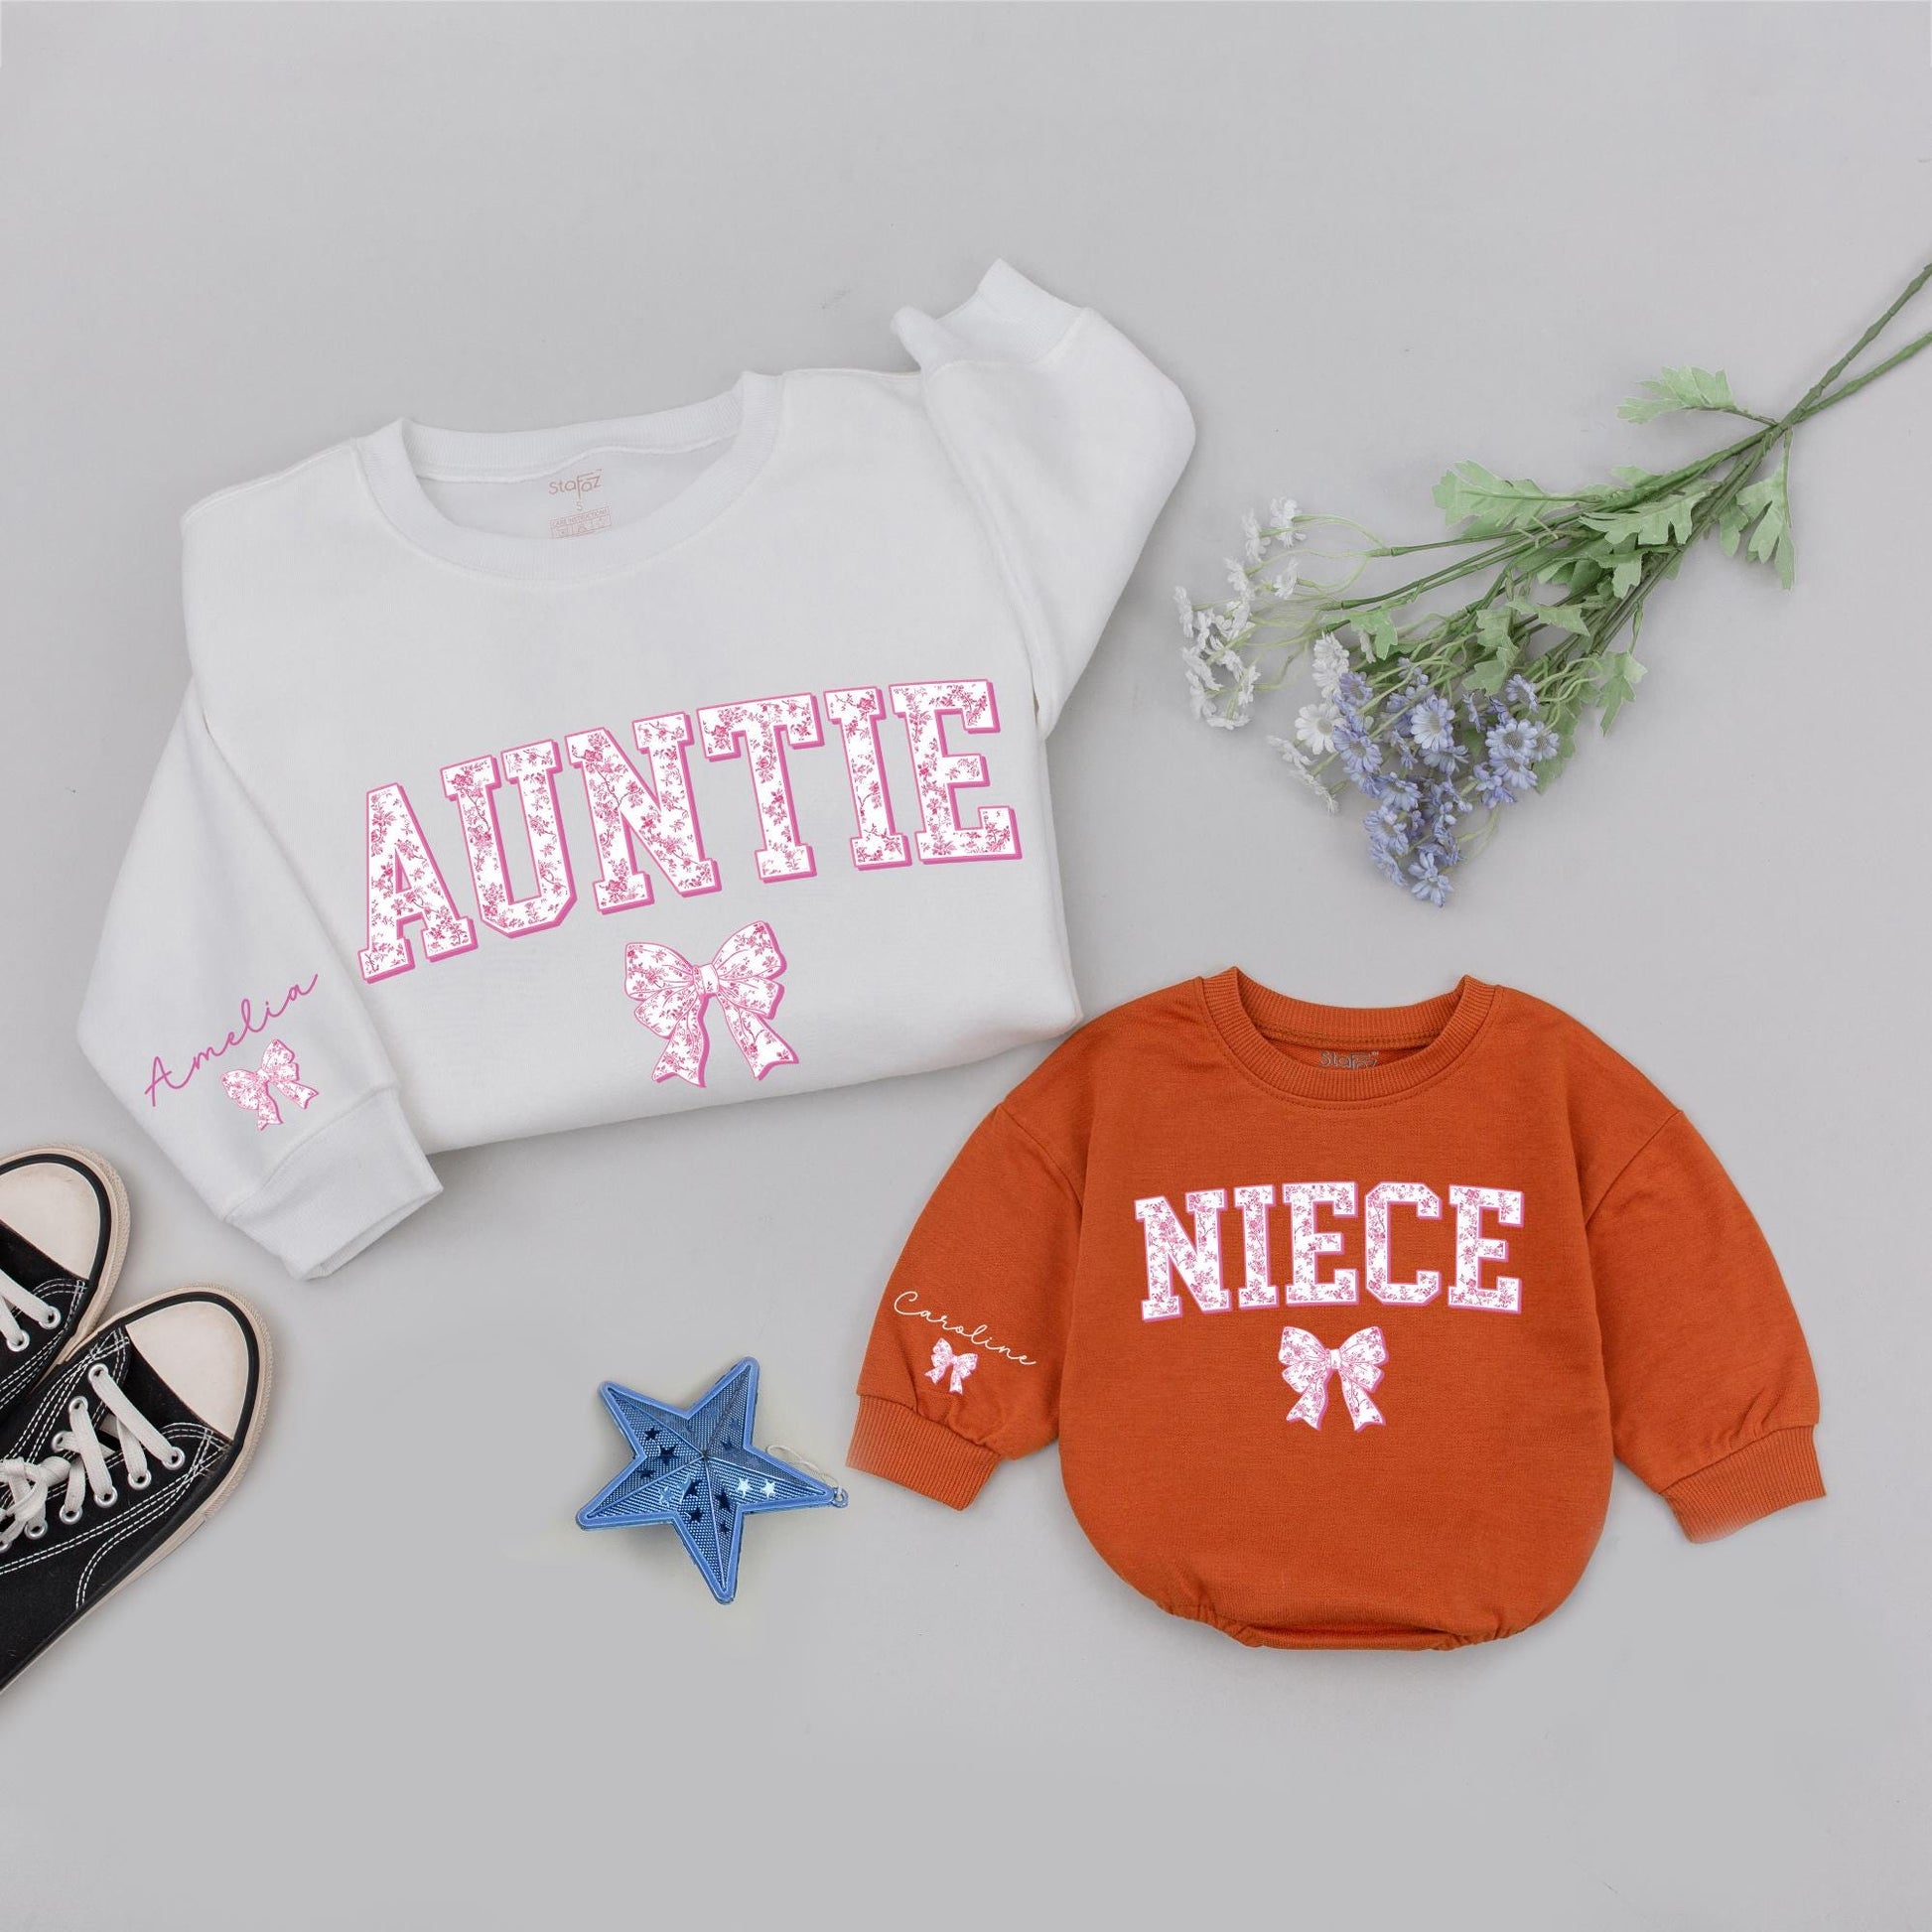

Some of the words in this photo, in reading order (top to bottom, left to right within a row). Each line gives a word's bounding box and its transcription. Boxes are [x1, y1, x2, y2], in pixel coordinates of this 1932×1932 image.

[358, 679, 1023, 984] AUNTIE
[145, 973, 318, 1107] Amelia
[1134, 1181, 1525, 1321] NIECE
[894, 1291, 1036, 1365] Caroline
